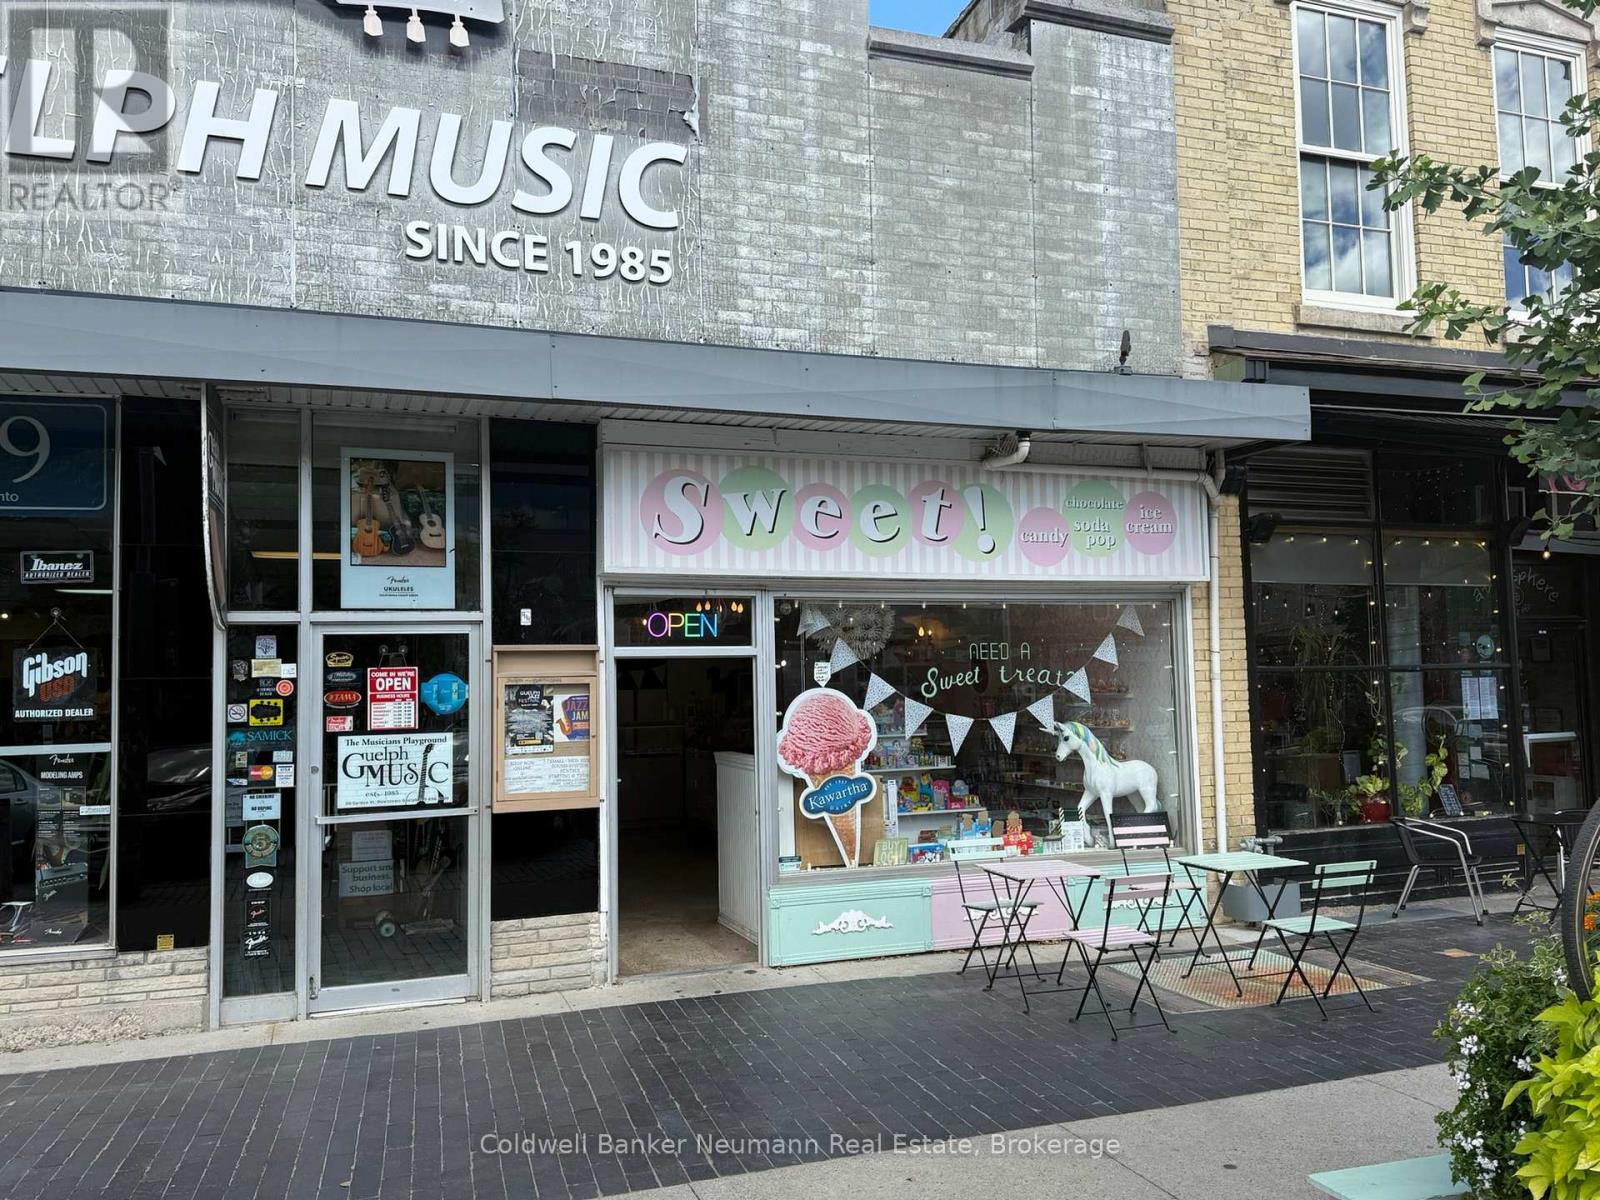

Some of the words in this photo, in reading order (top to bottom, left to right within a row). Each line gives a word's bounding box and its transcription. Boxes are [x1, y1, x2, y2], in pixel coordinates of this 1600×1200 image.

[0, 55, 279, 181] LPH
[305, 99, 688, 230] MUSIC
[405, 220, 548, 272] SINCE
[564, 239, 673, 285] 1985
[1065, 495, 1125, 511] chocolate
[653, 474, 996, 555] Sweet!
[1139, 504, 1162, 519] ice
[1074, 517, 1110, 533] soda
[1126, 520, 1173, 534] cream
[1021, 528, 1070, 548] candy
[1086, 534, 1117, 550] pop
[31, 558, 84, 571] Ibanez
[648, 612, 718, 638] OPEN
[970, 642, 1009, 660] NEED
[1020, 642, 1031, 660] A
[23, 652, 87, 698] Gibson
[921, 666, 980, 699] Sweet
[375, 677, 412, 691] OPEN
[15, 709, 63, 718] AUTHORIZED
[65, 708, 94, 717] DEALER
[566, 700, 589, 711] JAZZ
[572, 711, 589, 721] JAM
[247, 730, 292, 741] SAMICK
[362, 738, 401, 746] Musicians
[403, 736, 447, 745] Playground
[49, 753, 75, 765] Fender
[342, 745, 409, 779] Guelph
[41, 771, 67, 779] MODELING
[68, 771, 83, 779] AMPS
[808, 782, 866, 810] Kawartha
[342, 865, 379, 875] Support
